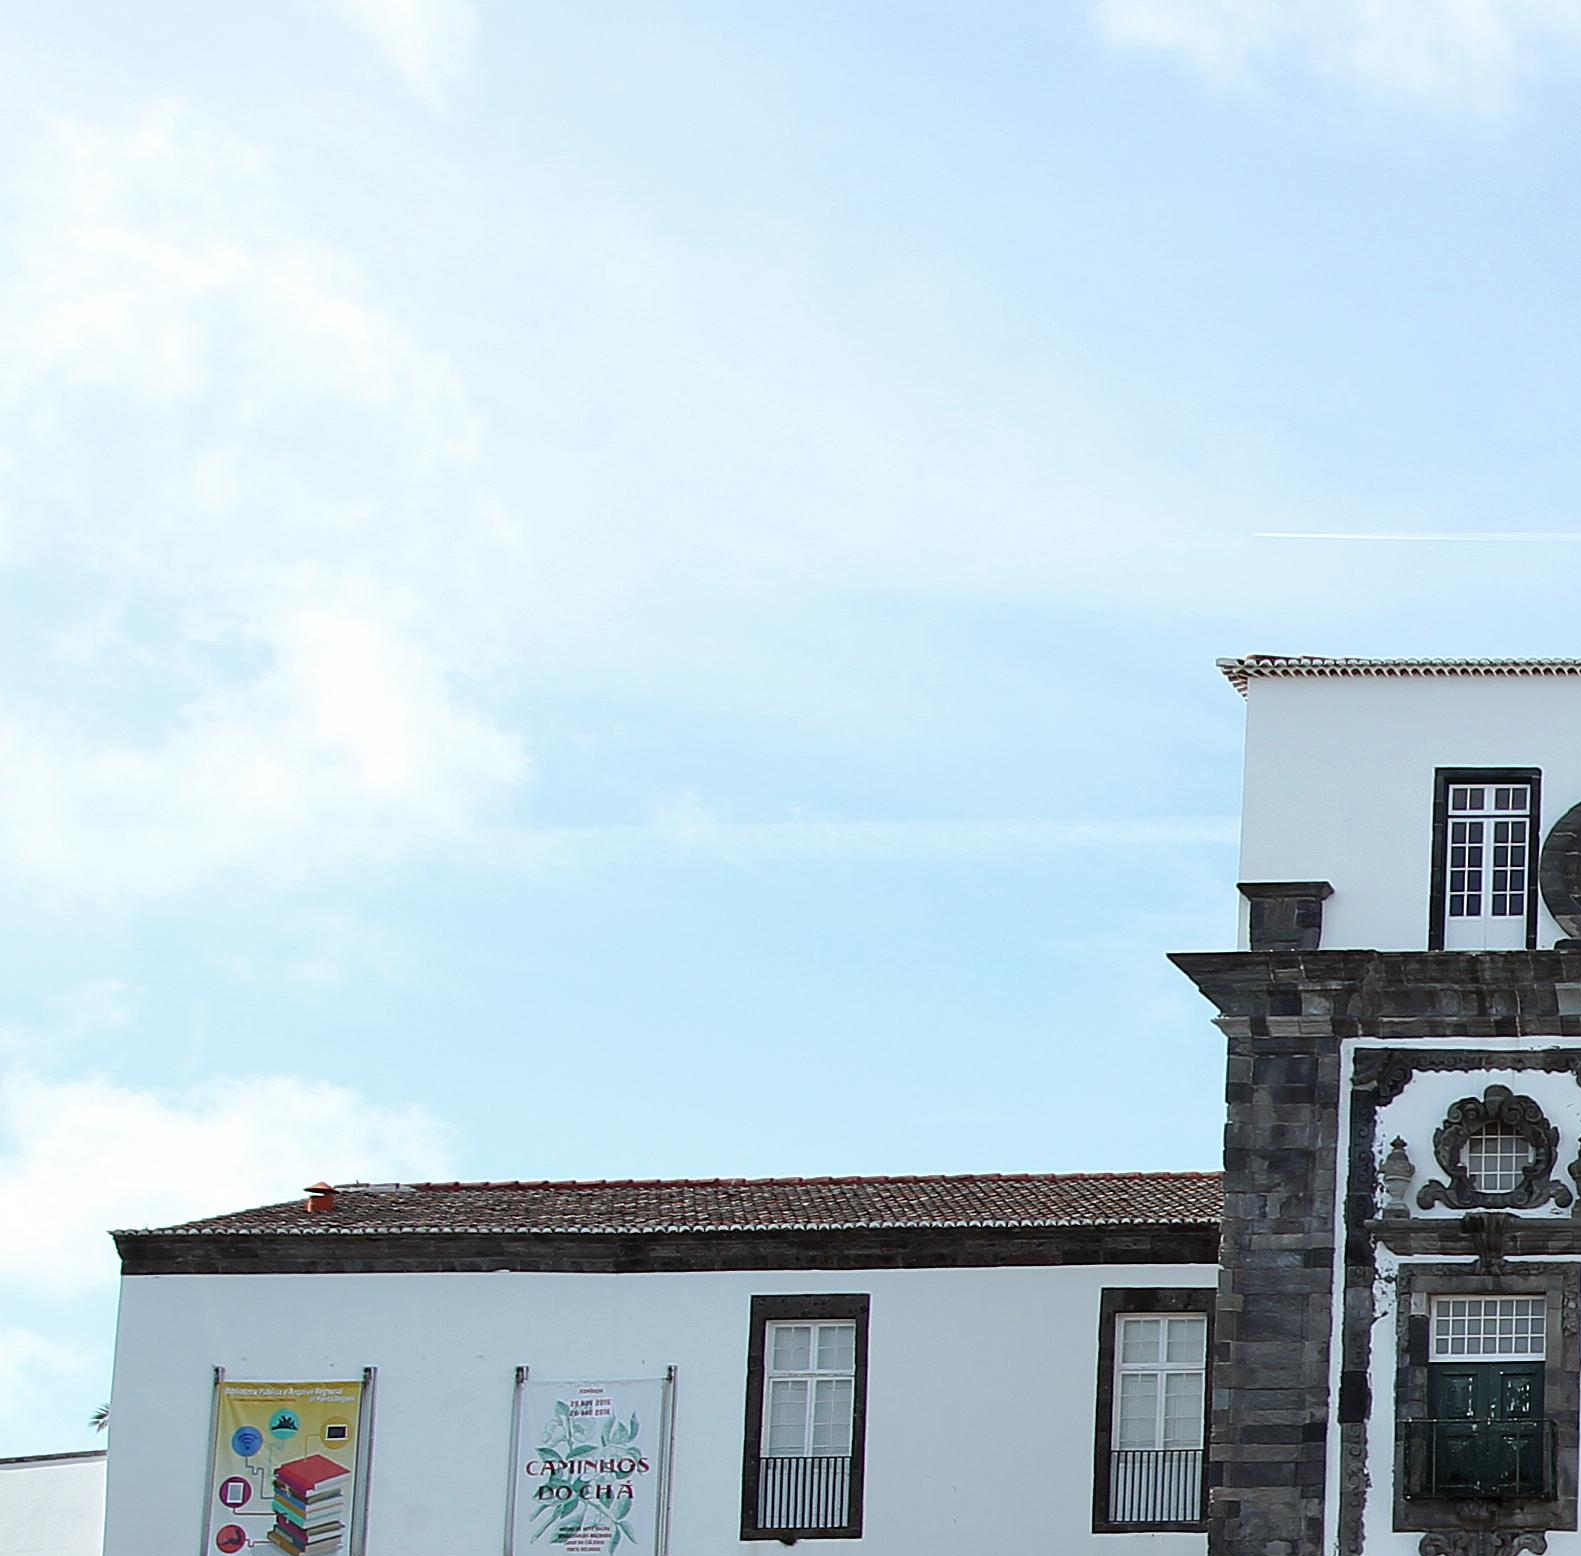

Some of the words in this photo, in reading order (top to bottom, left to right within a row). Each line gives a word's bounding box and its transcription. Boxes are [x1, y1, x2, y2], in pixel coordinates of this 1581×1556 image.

[526, 1457, 650, 1476] CAMINHOS
[538, 1485, 573, 1500] DO
[578, 1480, 634, 1500] CHÁ
